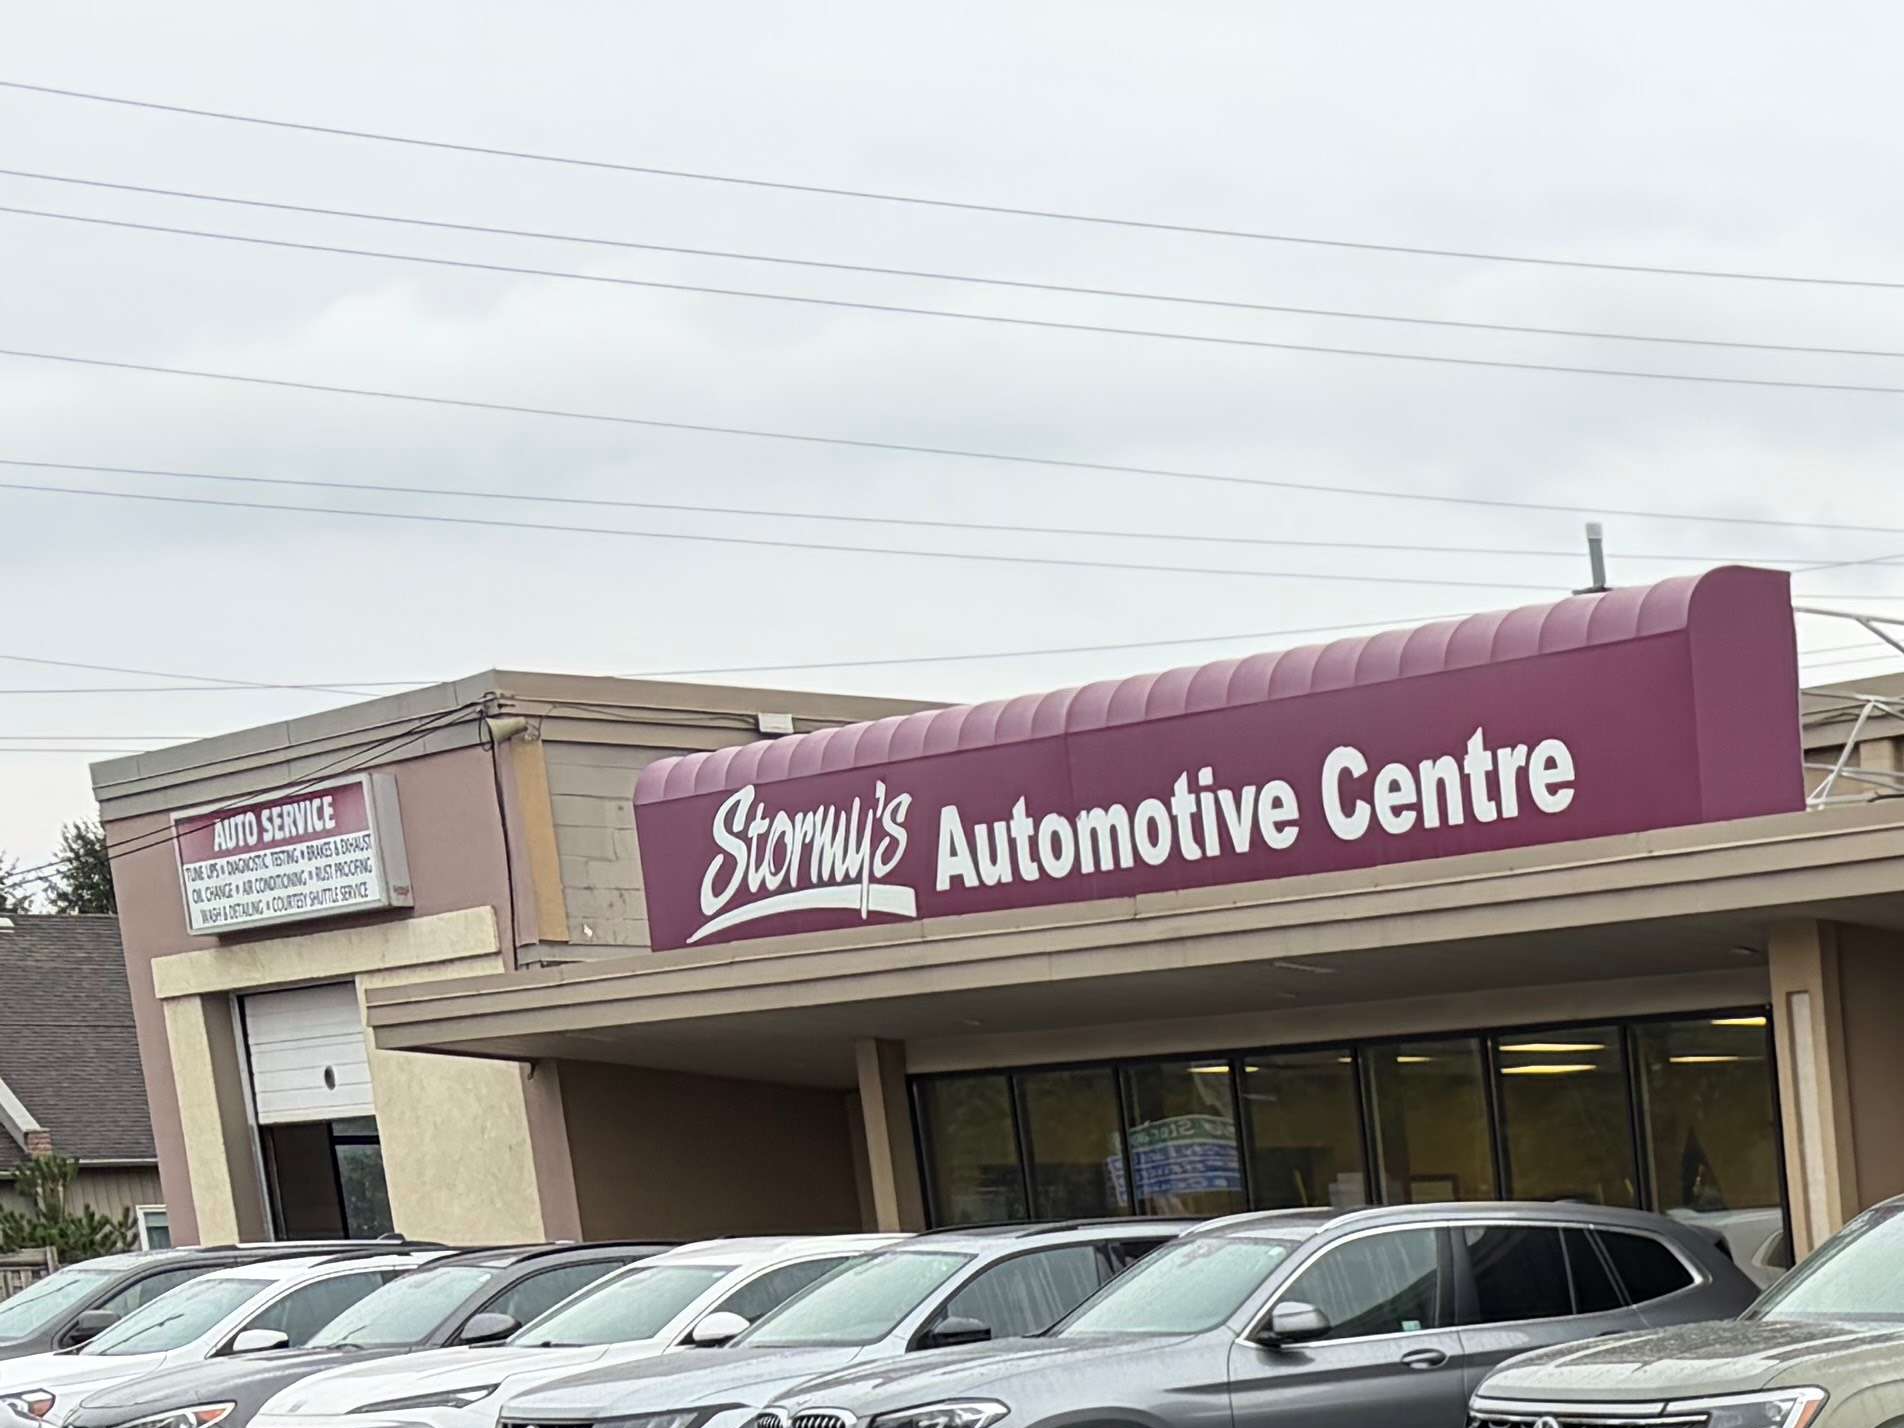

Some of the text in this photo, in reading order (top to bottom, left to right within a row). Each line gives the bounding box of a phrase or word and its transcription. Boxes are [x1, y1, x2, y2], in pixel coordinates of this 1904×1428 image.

[214, 796, 336, 851] AUTO SERVICE
[700, 726, 1576, 925] Stormy's Automotive Centre
